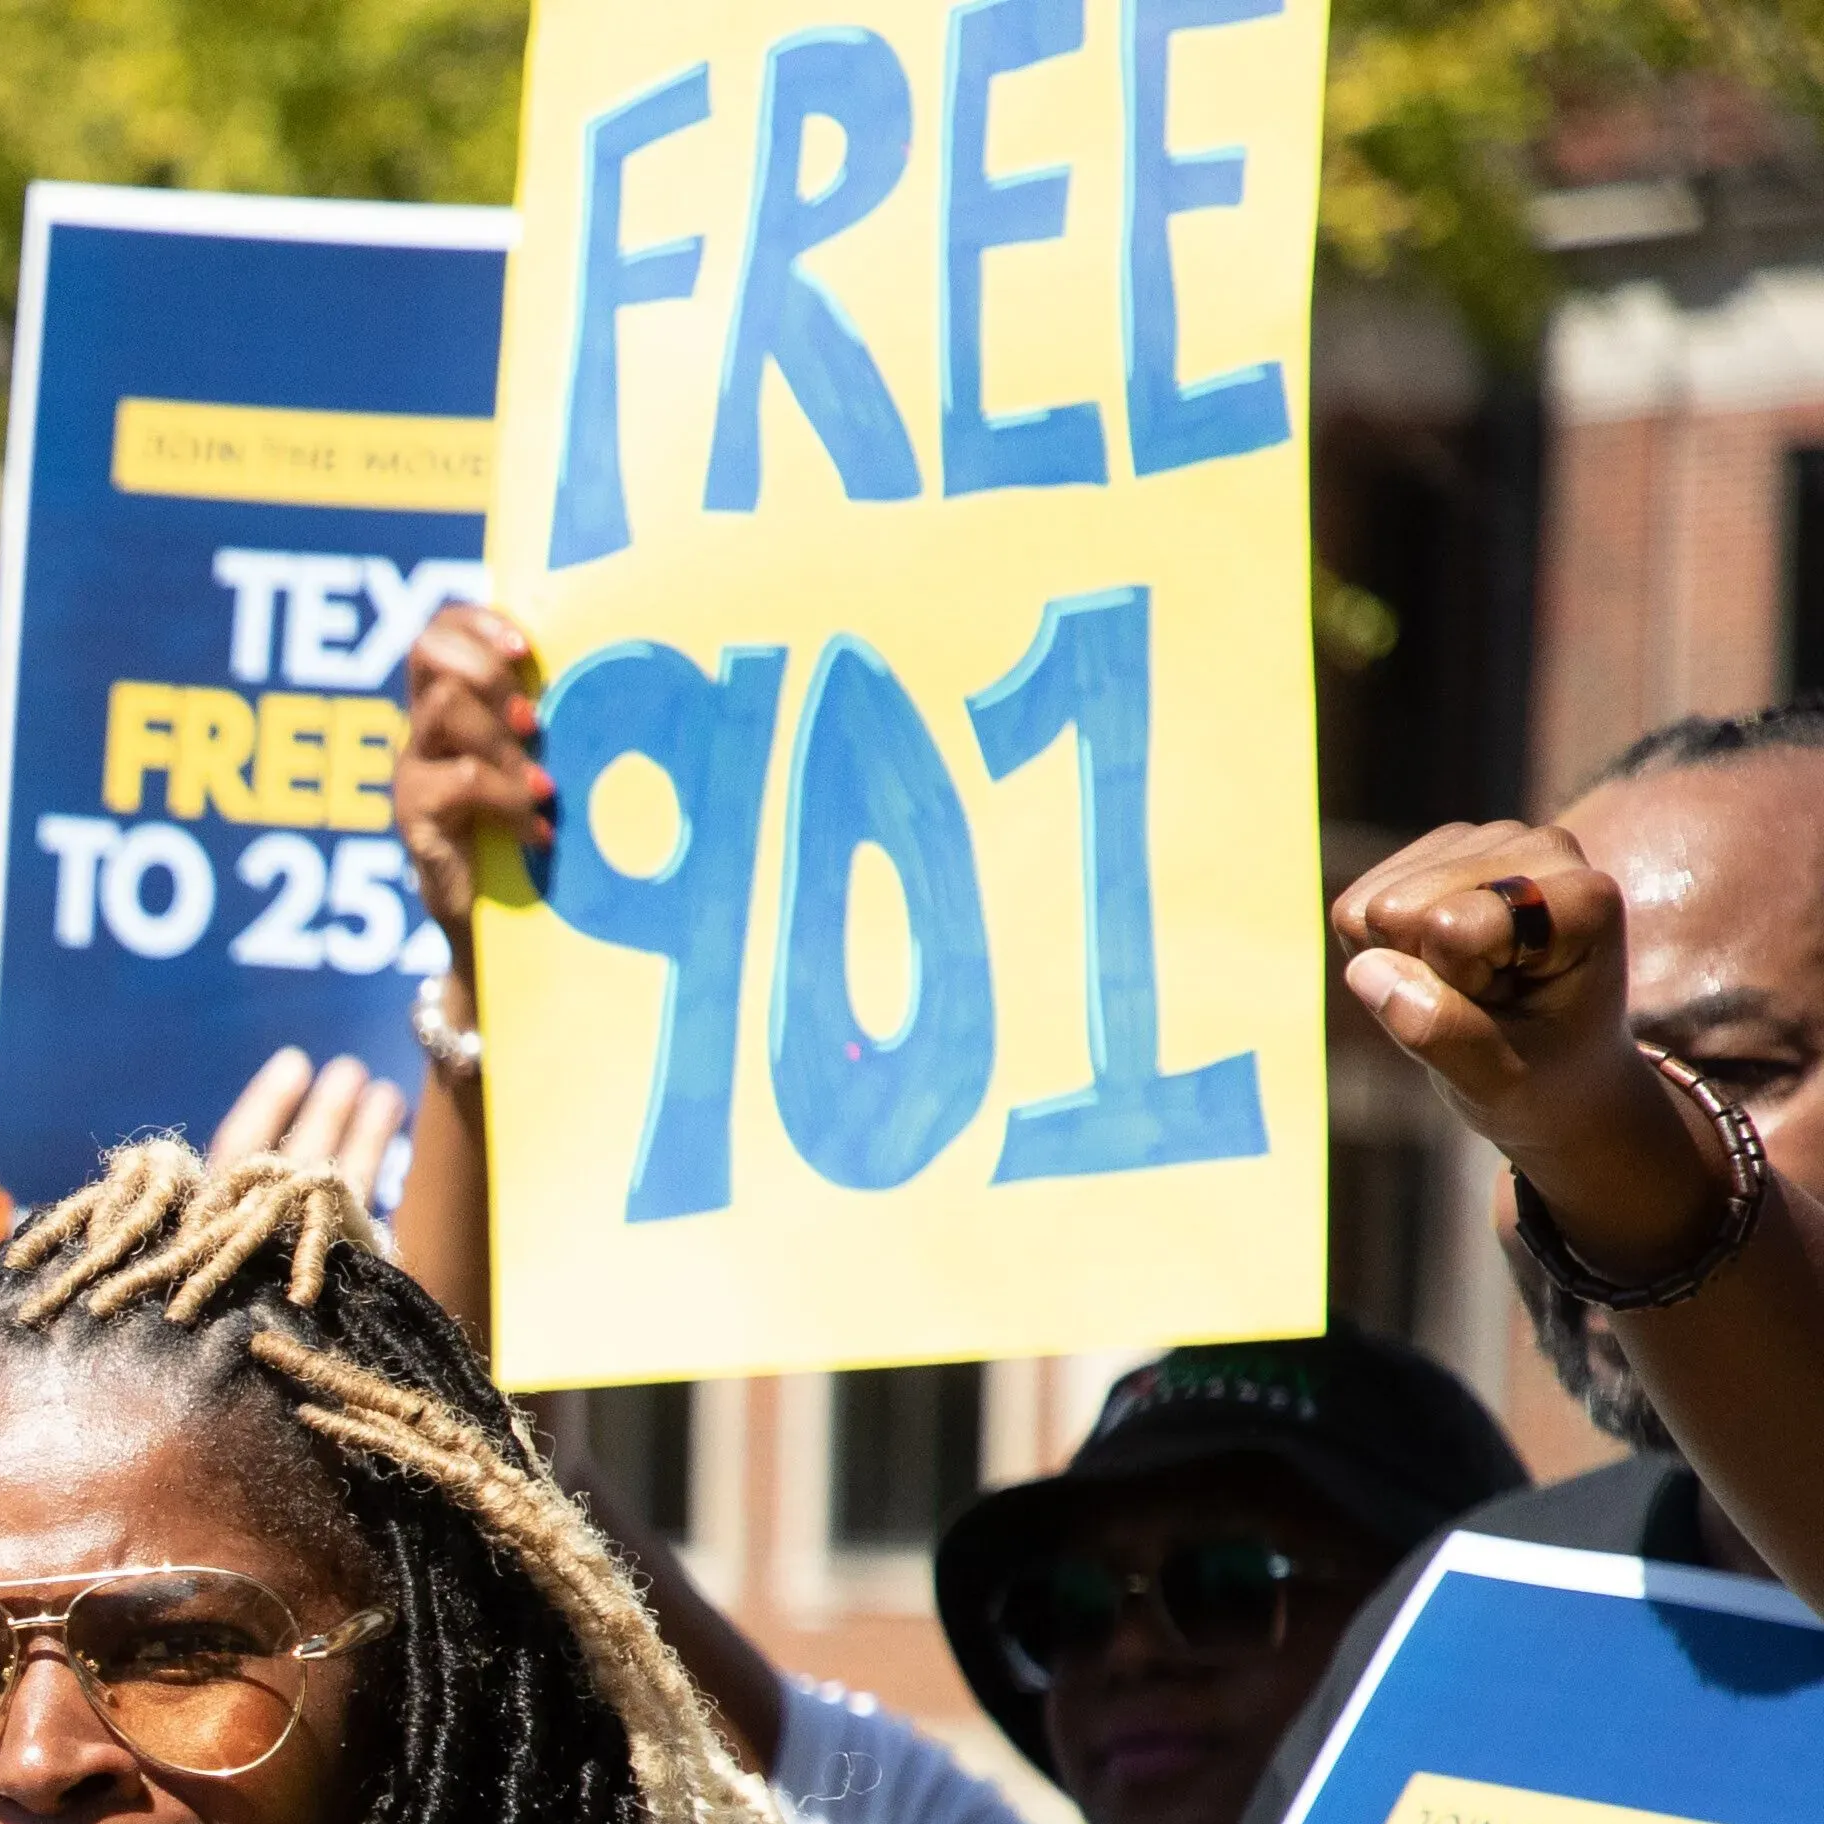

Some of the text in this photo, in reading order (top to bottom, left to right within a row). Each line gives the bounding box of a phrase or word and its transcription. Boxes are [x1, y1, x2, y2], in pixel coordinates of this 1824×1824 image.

[548, 0, 1293, 571] FREE
[35, 812, 218, 960] TO
[102, 678, 410, 834] FREE
[536, 584, 1270, 1224] 901
